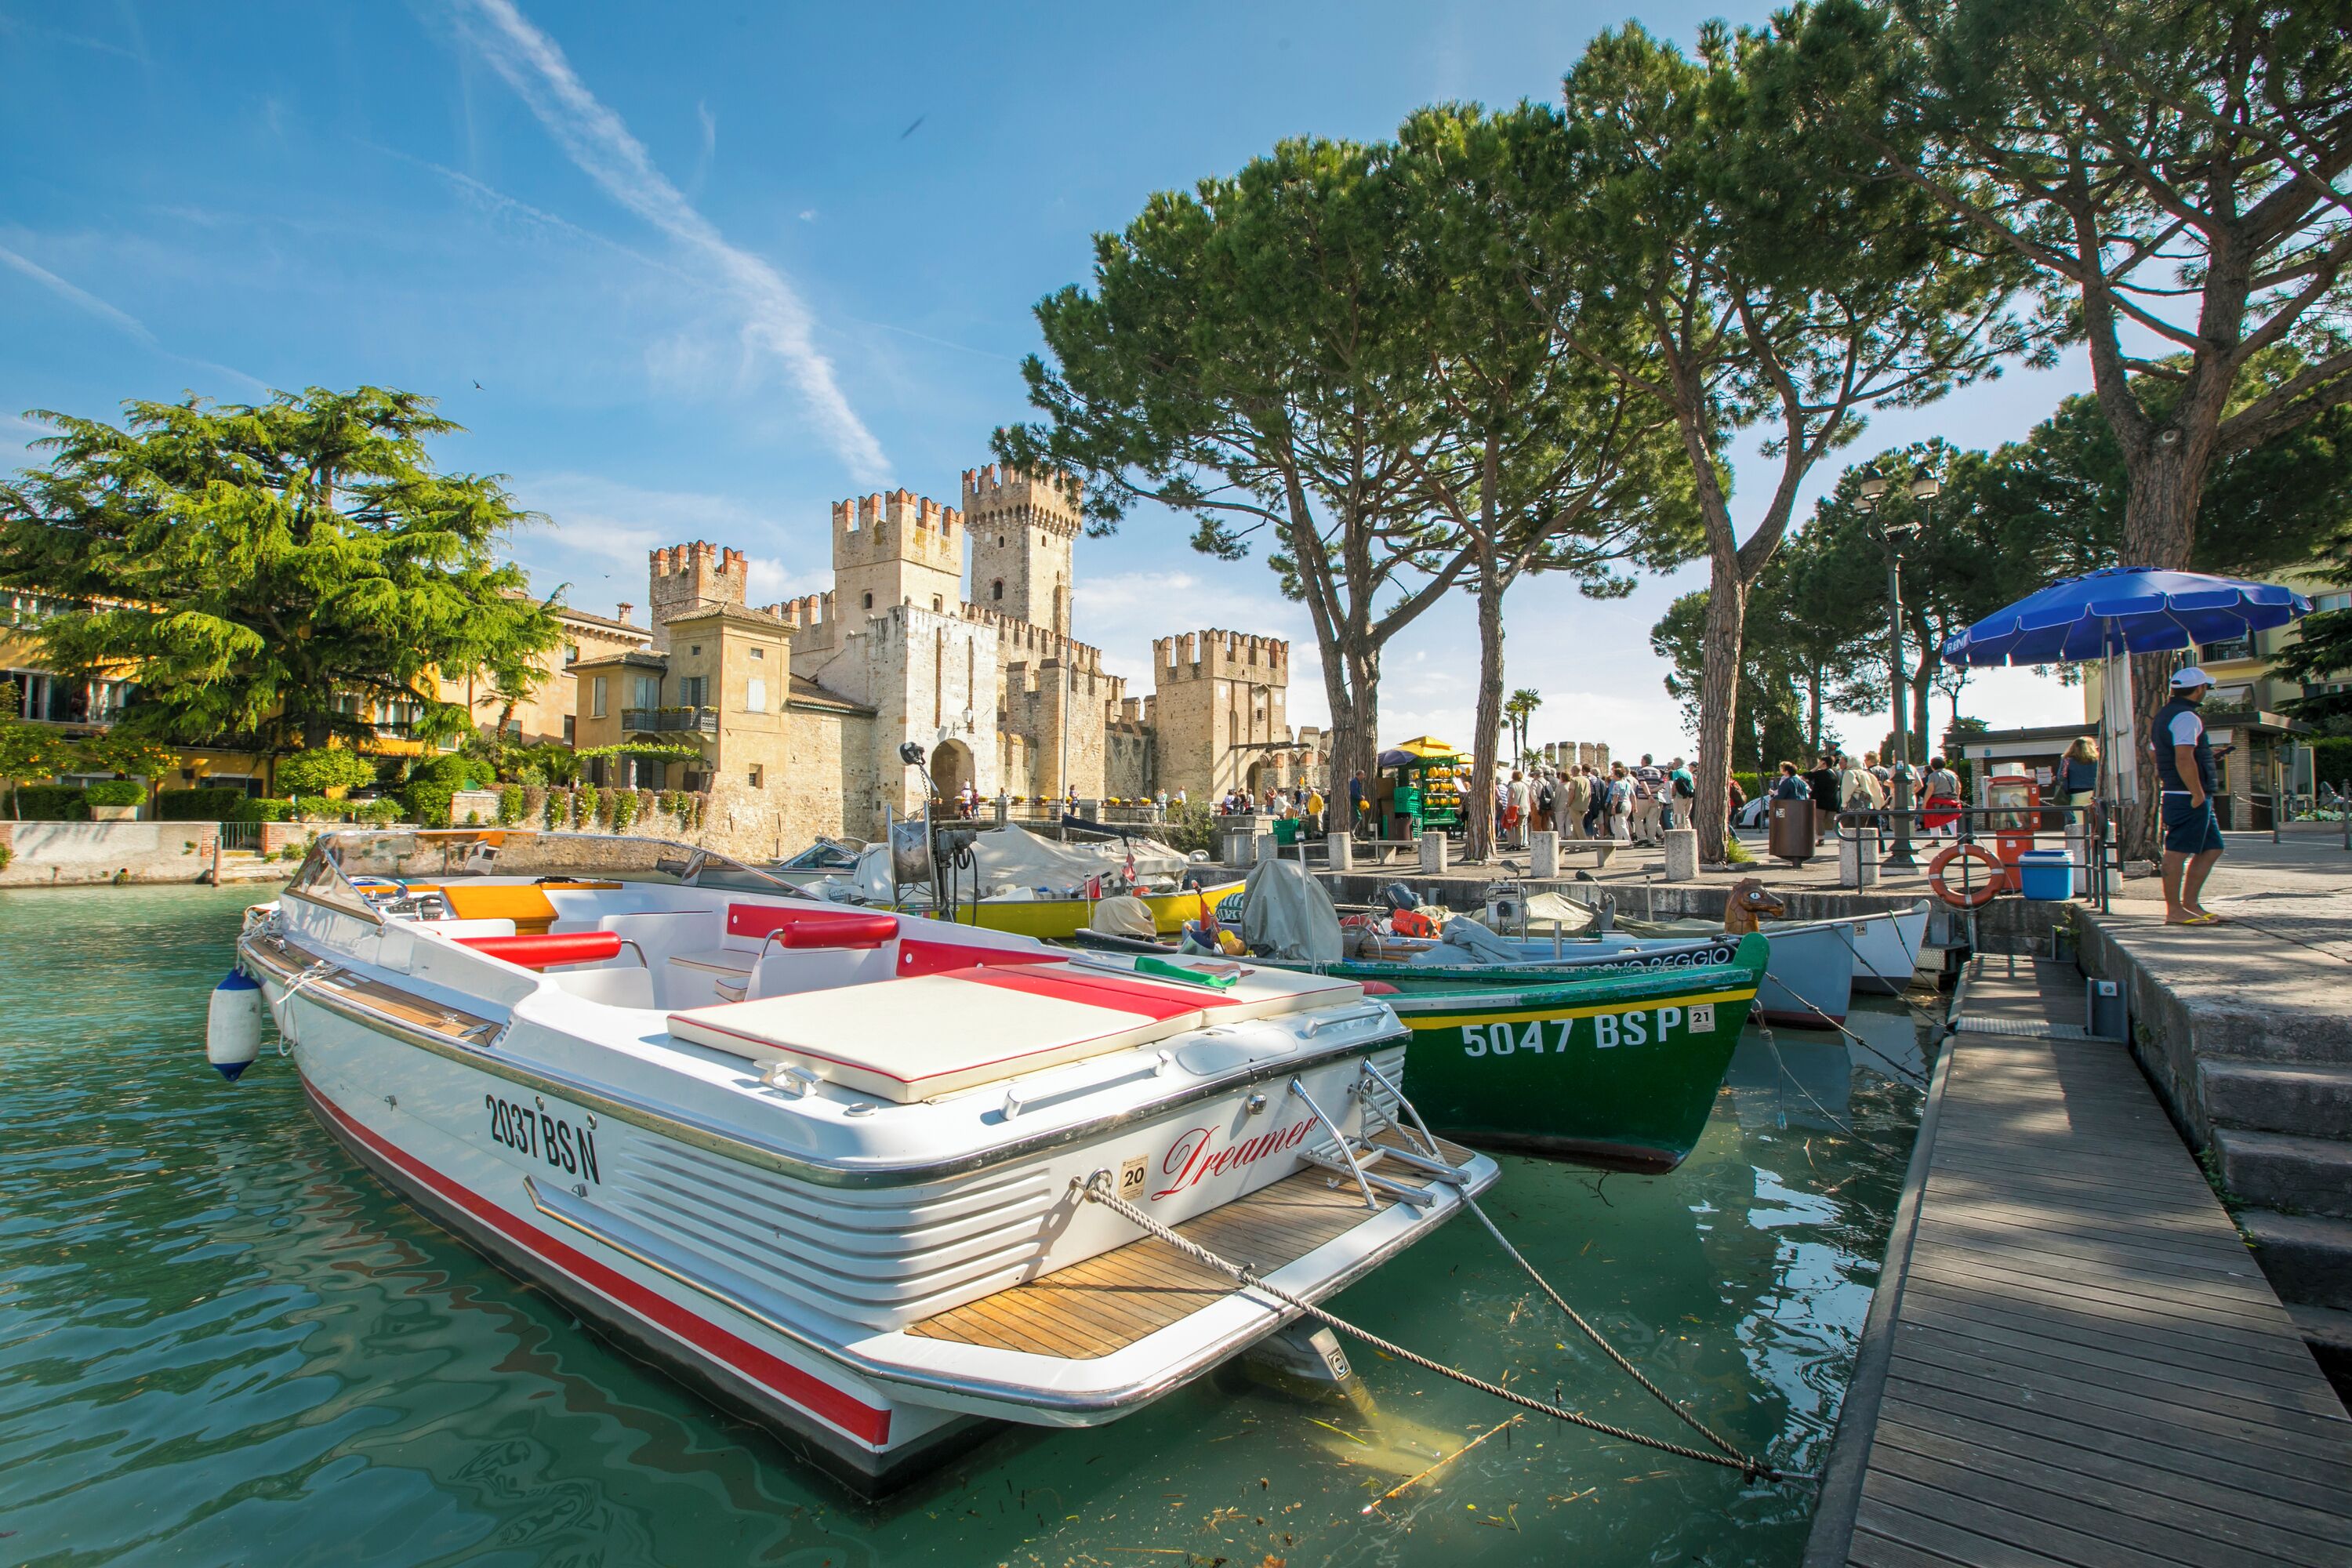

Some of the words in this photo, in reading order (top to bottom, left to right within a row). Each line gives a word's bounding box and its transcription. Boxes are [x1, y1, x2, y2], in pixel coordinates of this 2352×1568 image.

[1693, 1012, 1709, 1023] 21
[1462, 1018, 1573, 1057] 5047
[485, 1094, 538, 1159] 2037
[1123, 1167, 1145, 1188] 20
[1151, 1116, 1319, 1201] Dreamer
